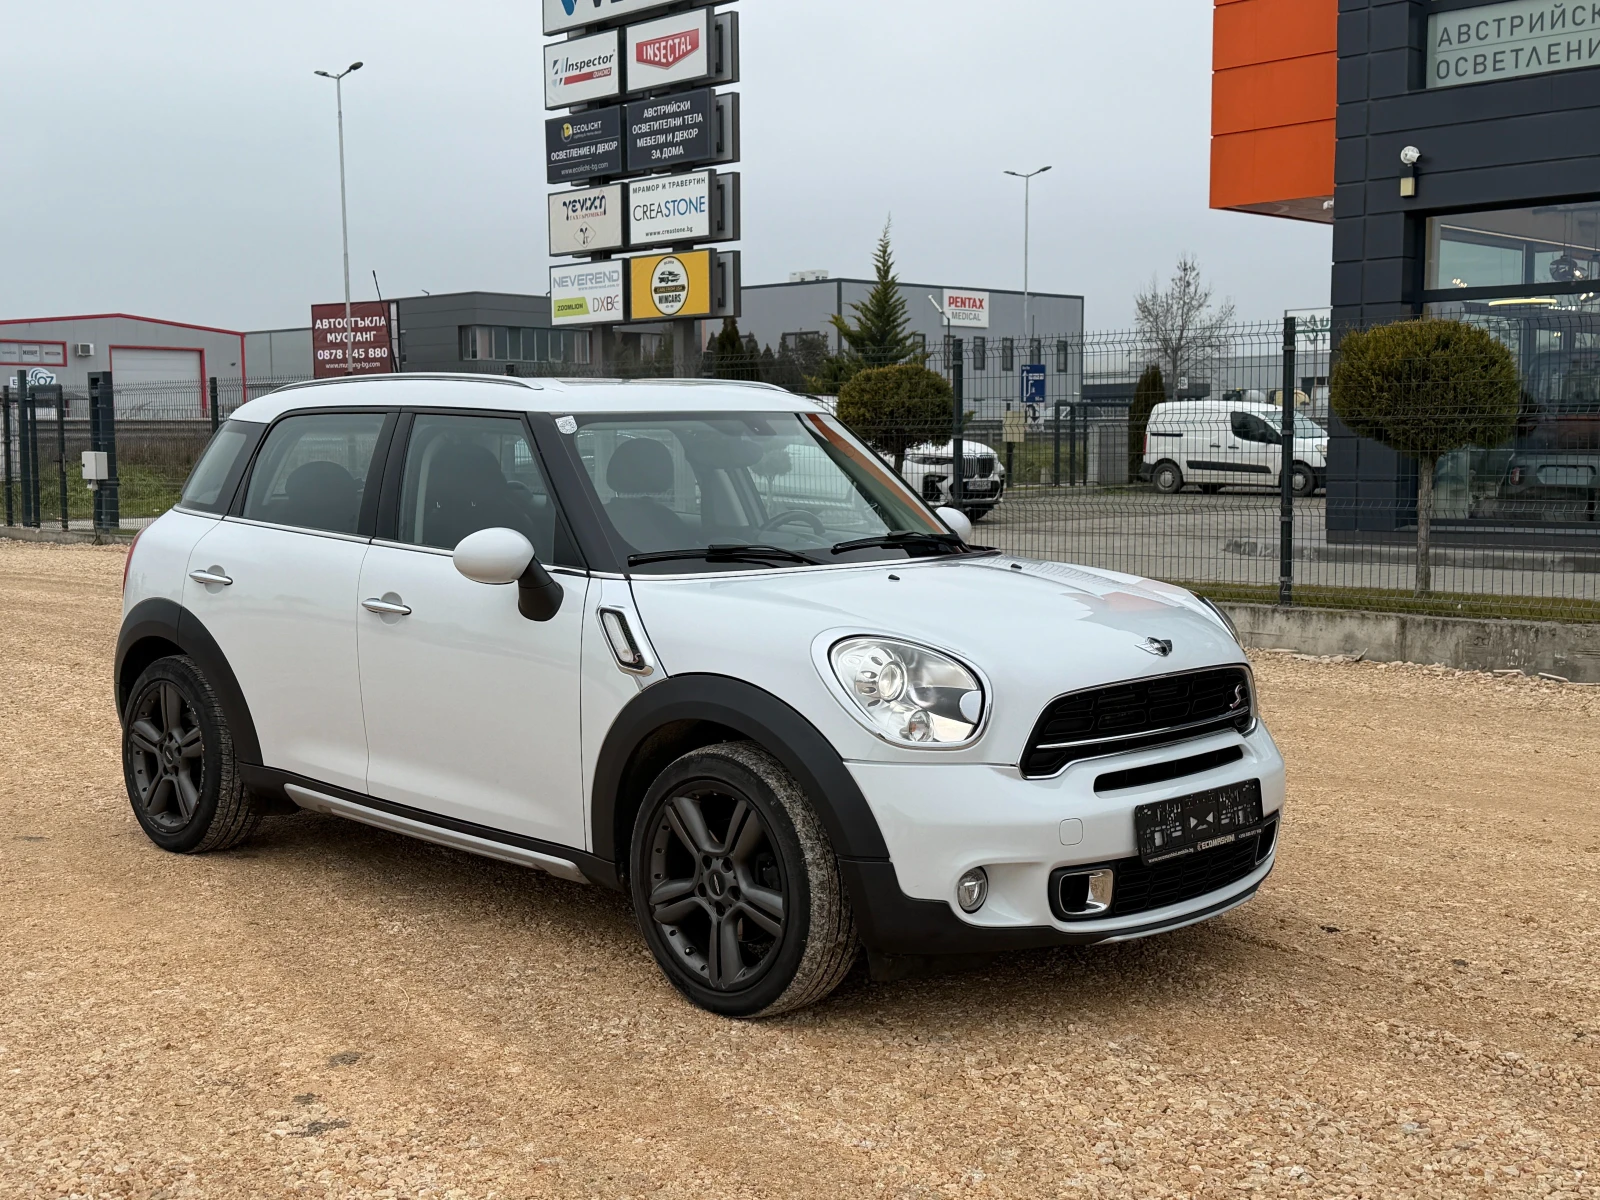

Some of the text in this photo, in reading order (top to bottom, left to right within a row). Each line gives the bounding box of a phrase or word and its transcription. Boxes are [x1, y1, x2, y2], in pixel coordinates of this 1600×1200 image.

[643, 35, 691, 63] INSECTAL
[565, 53, 614, 73] Inspector
[643, 100, 691, 118] АВСТРИЙСКИ
[632, 112, 703, 135] ОСВЕТИТЕЛНИ ТЕЛА
[636, 128, 699, 148] МЕБЕЛИ И ДЕКОР
[550, 141, 618, 161] ОСВЕТЛЕНИЕ И ДЕКОР
[651, 145, 684, 160] ЗА ДОМА
[632, 177, 706, 194] МРАМОР И ТРАВЕРТИН
[633, 195, 706, 222] CREASTONE
[645, 225, 694, 237] www.creastone.bg
[552, 270, 620, 288] NEVEREND
[557, 303, 584, 312] ZOOMLION
[948, 296, 985, 310] PENTAX
[951, 311, 982, 321] MEDICAL
[317, 349, 343, 360] 0878
[368, 347, 388, 358] 880
